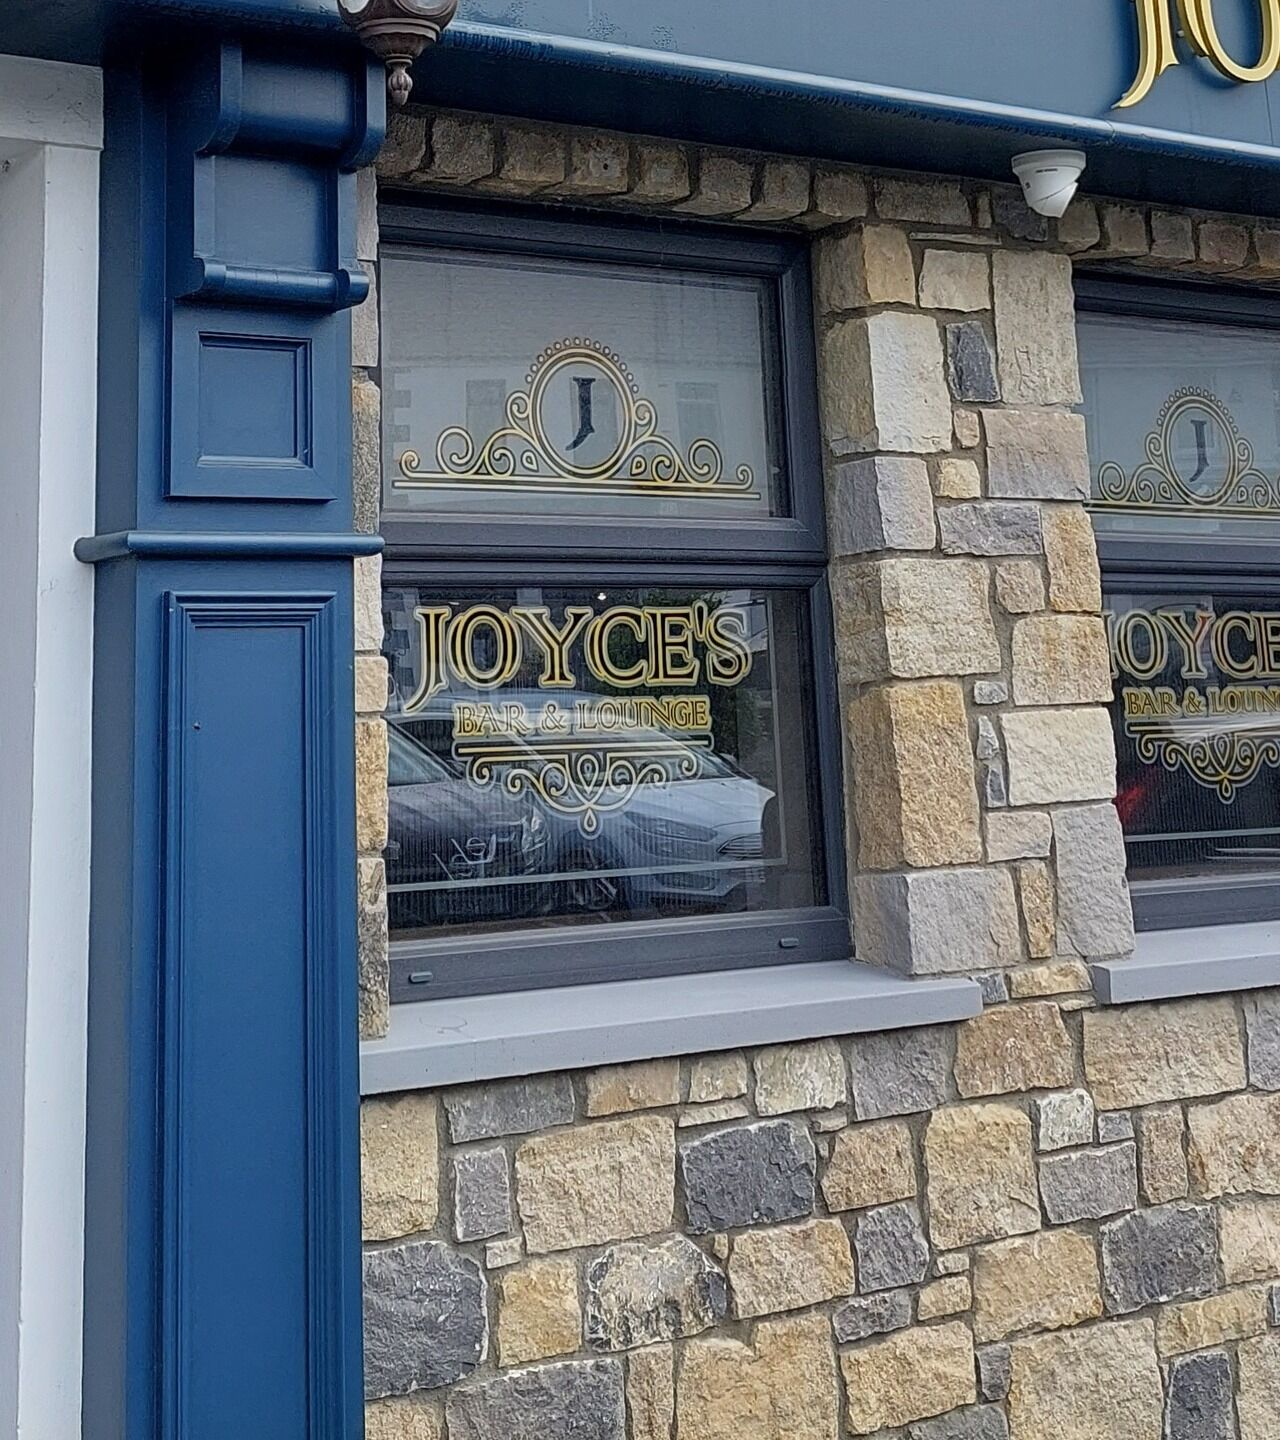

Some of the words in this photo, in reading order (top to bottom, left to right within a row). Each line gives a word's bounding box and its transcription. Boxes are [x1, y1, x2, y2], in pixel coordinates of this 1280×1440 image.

[565, 376, 596, 451] J
[1189, 419, 1210, 483] J
[403, 600, 753, 713] JOYCE'S
[454, 701, 530, 737] BAR
[540, 703, 567, 732] &
[576, 696, 712, 732] LOUNGE
[1124, 687, 1180, 717] BAR
[1184, 687, 1203, 715] &
